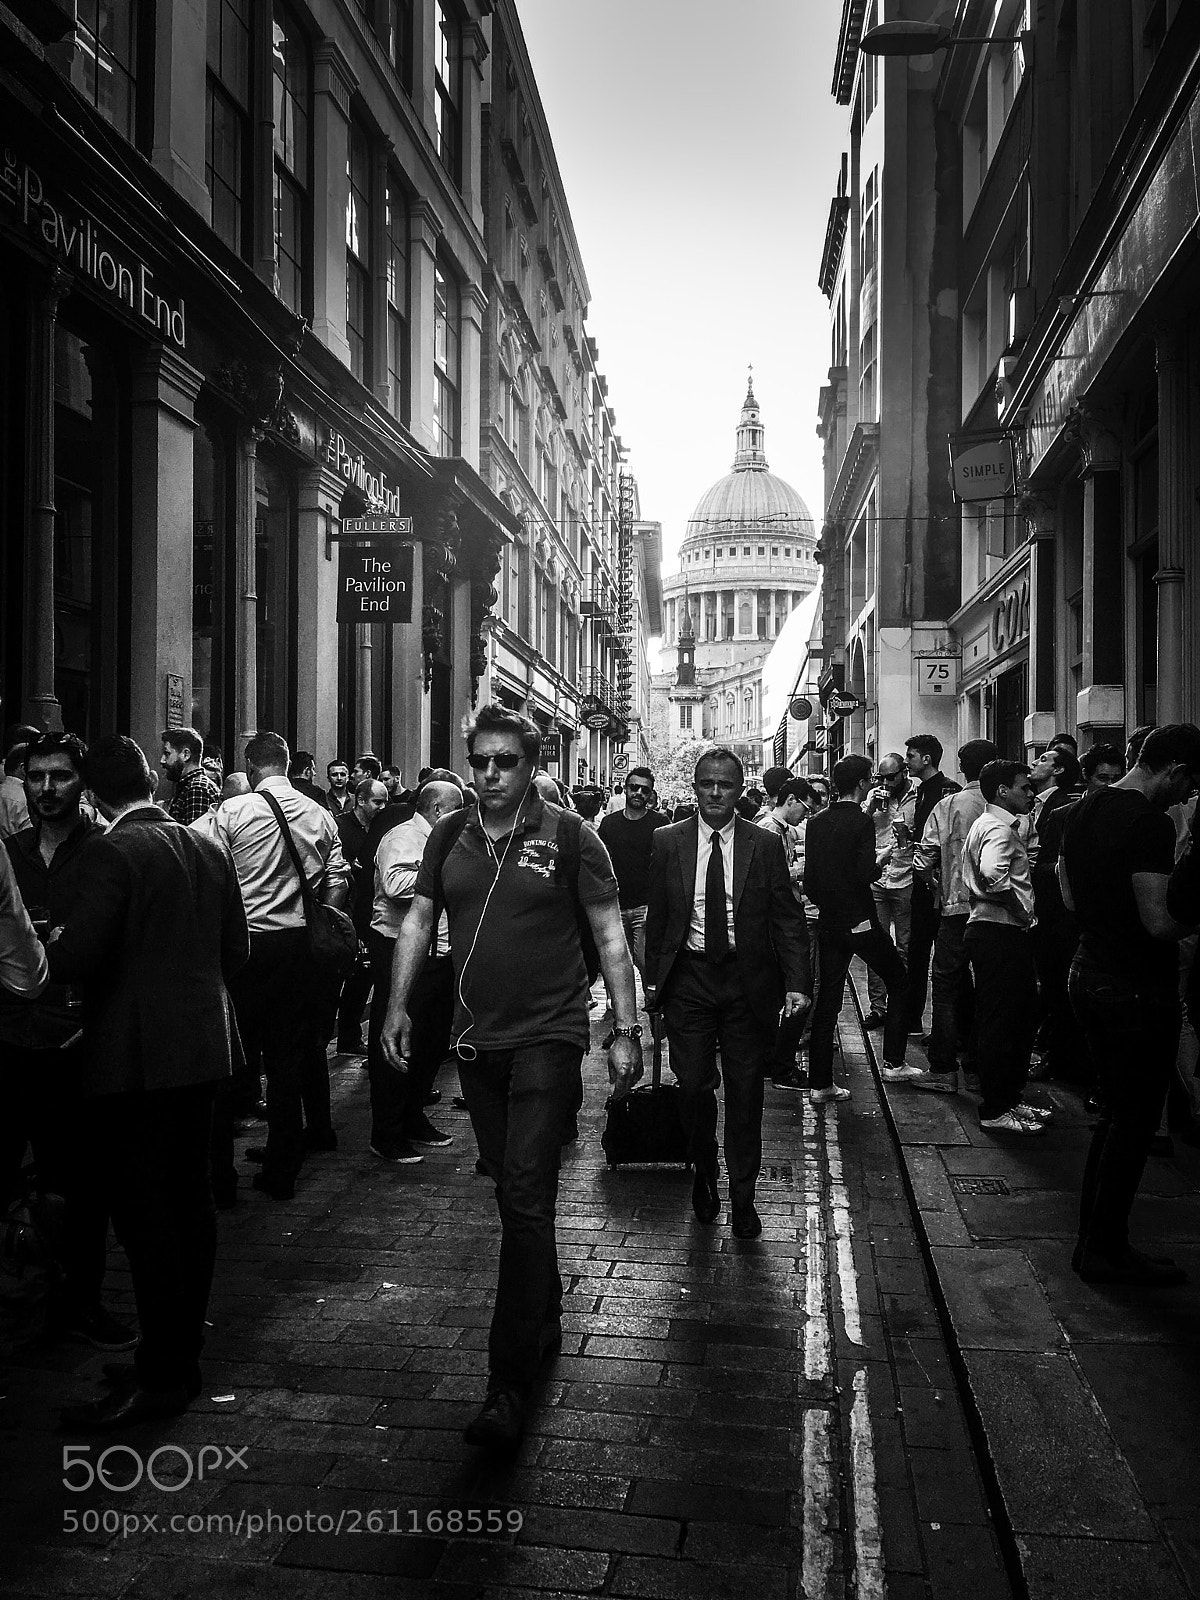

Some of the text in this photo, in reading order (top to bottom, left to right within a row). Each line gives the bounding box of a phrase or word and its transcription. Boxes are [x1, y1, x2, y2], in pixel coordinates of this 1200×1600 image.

[23, 162, 134, 309] Pavilion
[138, 263, 186, 349] End
[327, 428, 401, 517] The Pavilion End
[962, 463, 1005, 478] SIMPLE
[361, 557, 392, 573] The
[345, 577, 406, 593] Pavilion
[360, 596, 390, 612] End
[926, 664, 949, 679] 75
